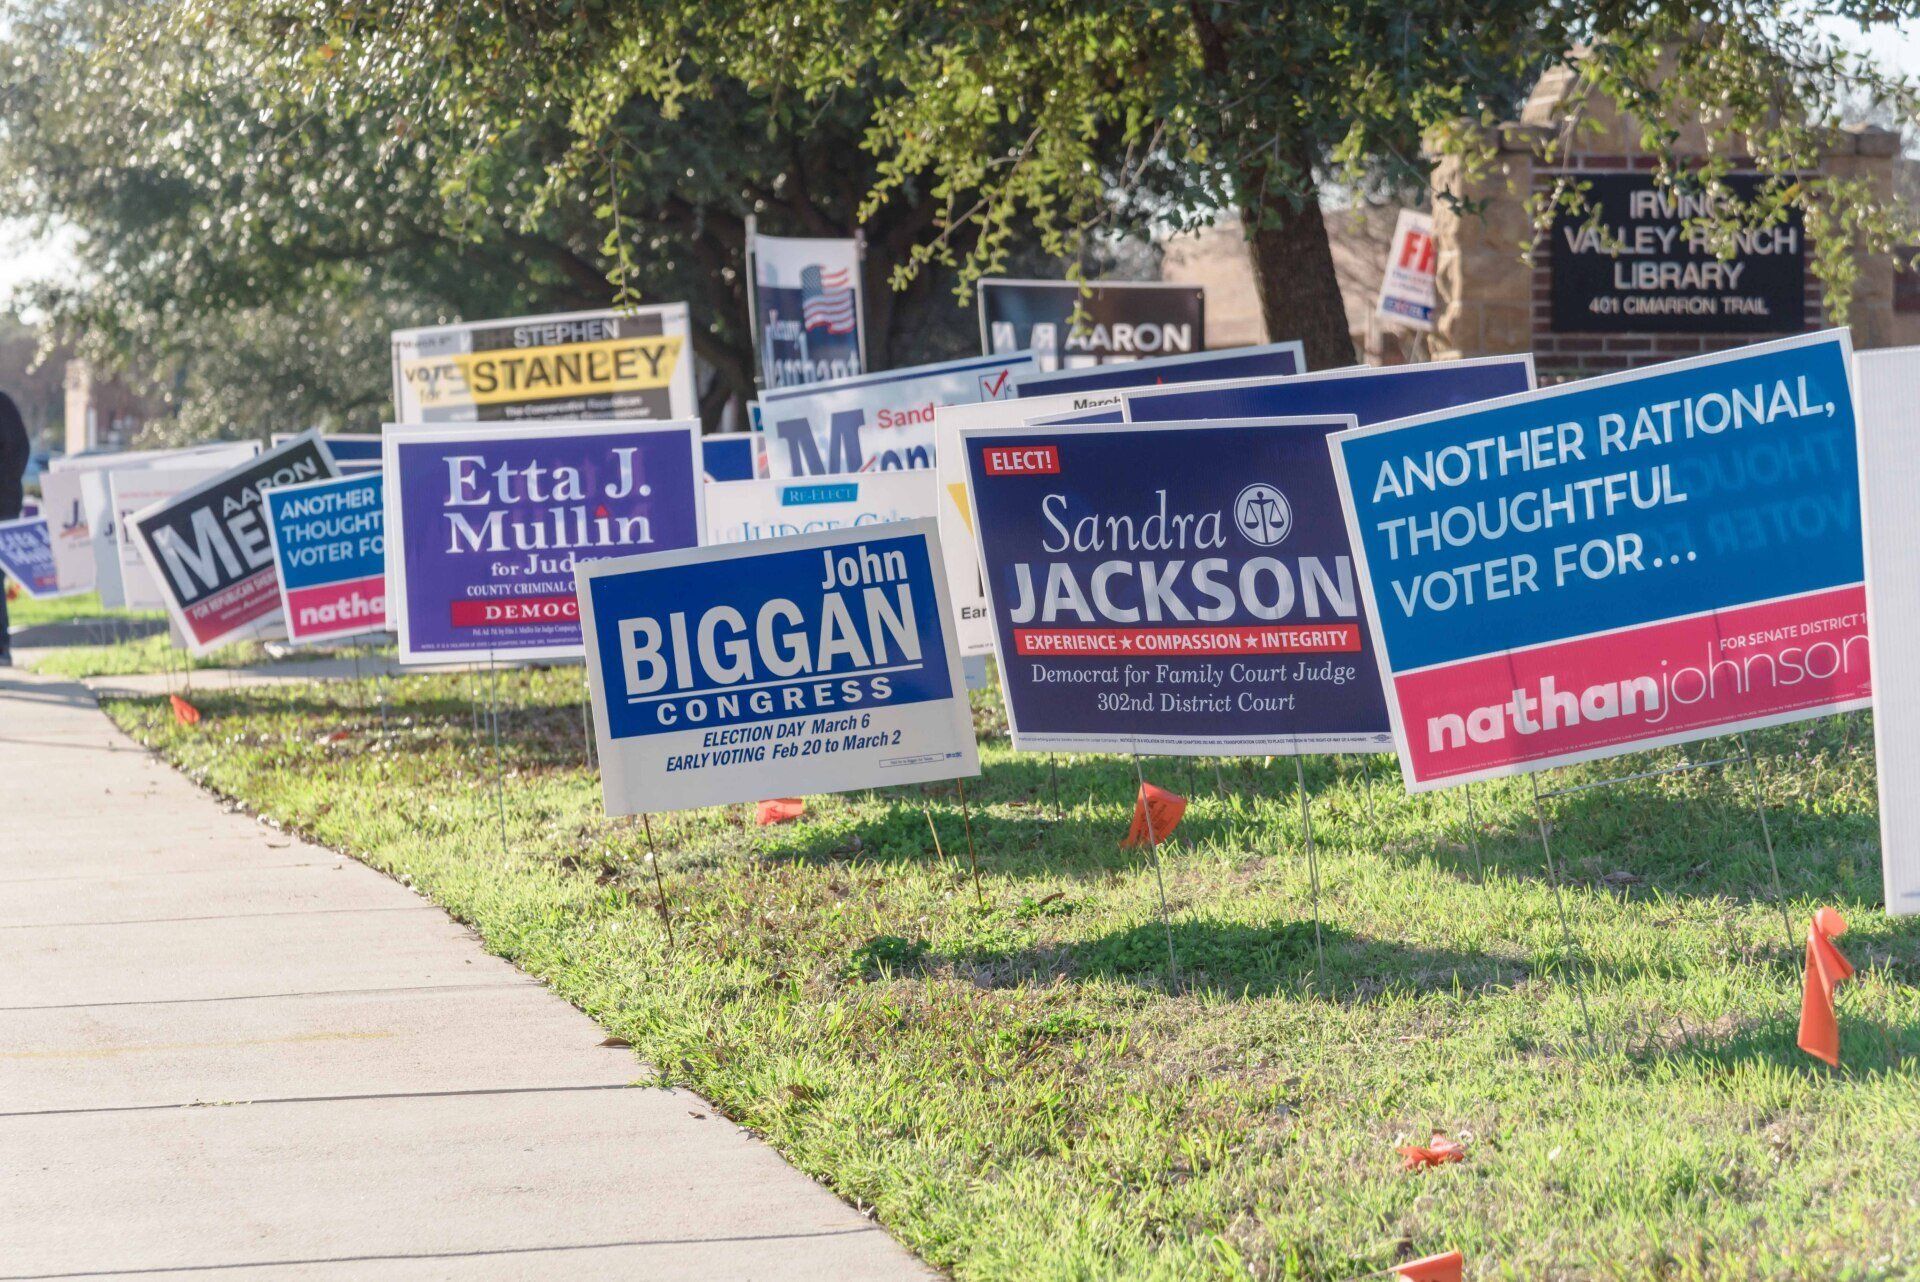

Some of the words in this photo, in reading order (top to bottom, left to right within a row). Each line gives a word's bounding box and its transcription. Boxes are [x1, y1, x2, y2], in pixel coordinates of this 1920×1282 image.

[1689, 226, 1798, 255] RNCH
[1614, 261, 1745, 290] LIBRARY
[1589, 297, 1620, 315] 401
[1623, 297, 1717, 315] CIMARRON
[1722, 297, 1769, 315] TRAIL
[514, 319, 620, 348] STEPHEN
[473, 345, 666, 394] STANLEY
[877, 402, 936, 430] Sand
[1372, 421, 1585, 503] ANOTHER
[1598, 374, 1836, 456] RATIONAL,
[443, 454, 586, 506] Etta
[604, 447, 652, 499] J.
[991, 449, 1052, 471] ELECT!
[280, 486, 376, 520] ANOTHER
[1377, 463, 1688, 560] THOUGHTFUL
[282, 509, 384, 543] THOUGHT
[443, 504, 654, 554] Mullin
[1041, 490, 1227, 553] Sandra
[152, 503, 274, 601] ME
[288, 540, 353, 568] VOTER
[491, 561, 519, 577] for
[523, 551, 614, 575] Jud
[821, 545, 908, 590] John
[467, 582, 511, 597] COUNTY
[514, 581, 566, 596] CRIMINAL
[1010, 556, 1358, 624] JACKSON
[1391, 554, 1540, 618] VOTER
[485, 601, 577, 621] DEMOC
[617, 583, 923, 696] BIGGAN
[1024, 633, 1118, 651] EXPERIENCE
[1136, 631, 1241, 650] COMPASSION
[1261, 630, 1349, 648] INTEGRITY
[1720, 635, 1746, 651] FOR
[1749, 625, 1798, 646] SENATE
[1800, 613, 1858, 636] DISTRICT
[1032, 664, 1120, 684] Democrat
[1125, 664, 1150, 687] for
[1155, 664, 1223, 688] Family
[1229, 663, 1287, 683] Court
[1293, 661, 1356, 684] Judge
[657, 676, 893, 726] CONGRESS
[1097, 692, 1154, 712] 302nd
[1160, 691, 1231, 712] District
[1238, 692, 1295, 712] Court
[703, 725, 774, 748] ELECTION
[776, 721, 805, 739] DAY
[811, 715, 857, 735] March
[861, 713, 870, 728] 6
[666, 753, 710, 772] EARLY
[712, 746, 765, 767] VOTING
[772, 742, 798, 760] Feb
[802, 739, 822, 756] 20
[825, 738, 839, 753] to
[842, 733, 888, 751] March
[891, 729, 902, 745] 2
